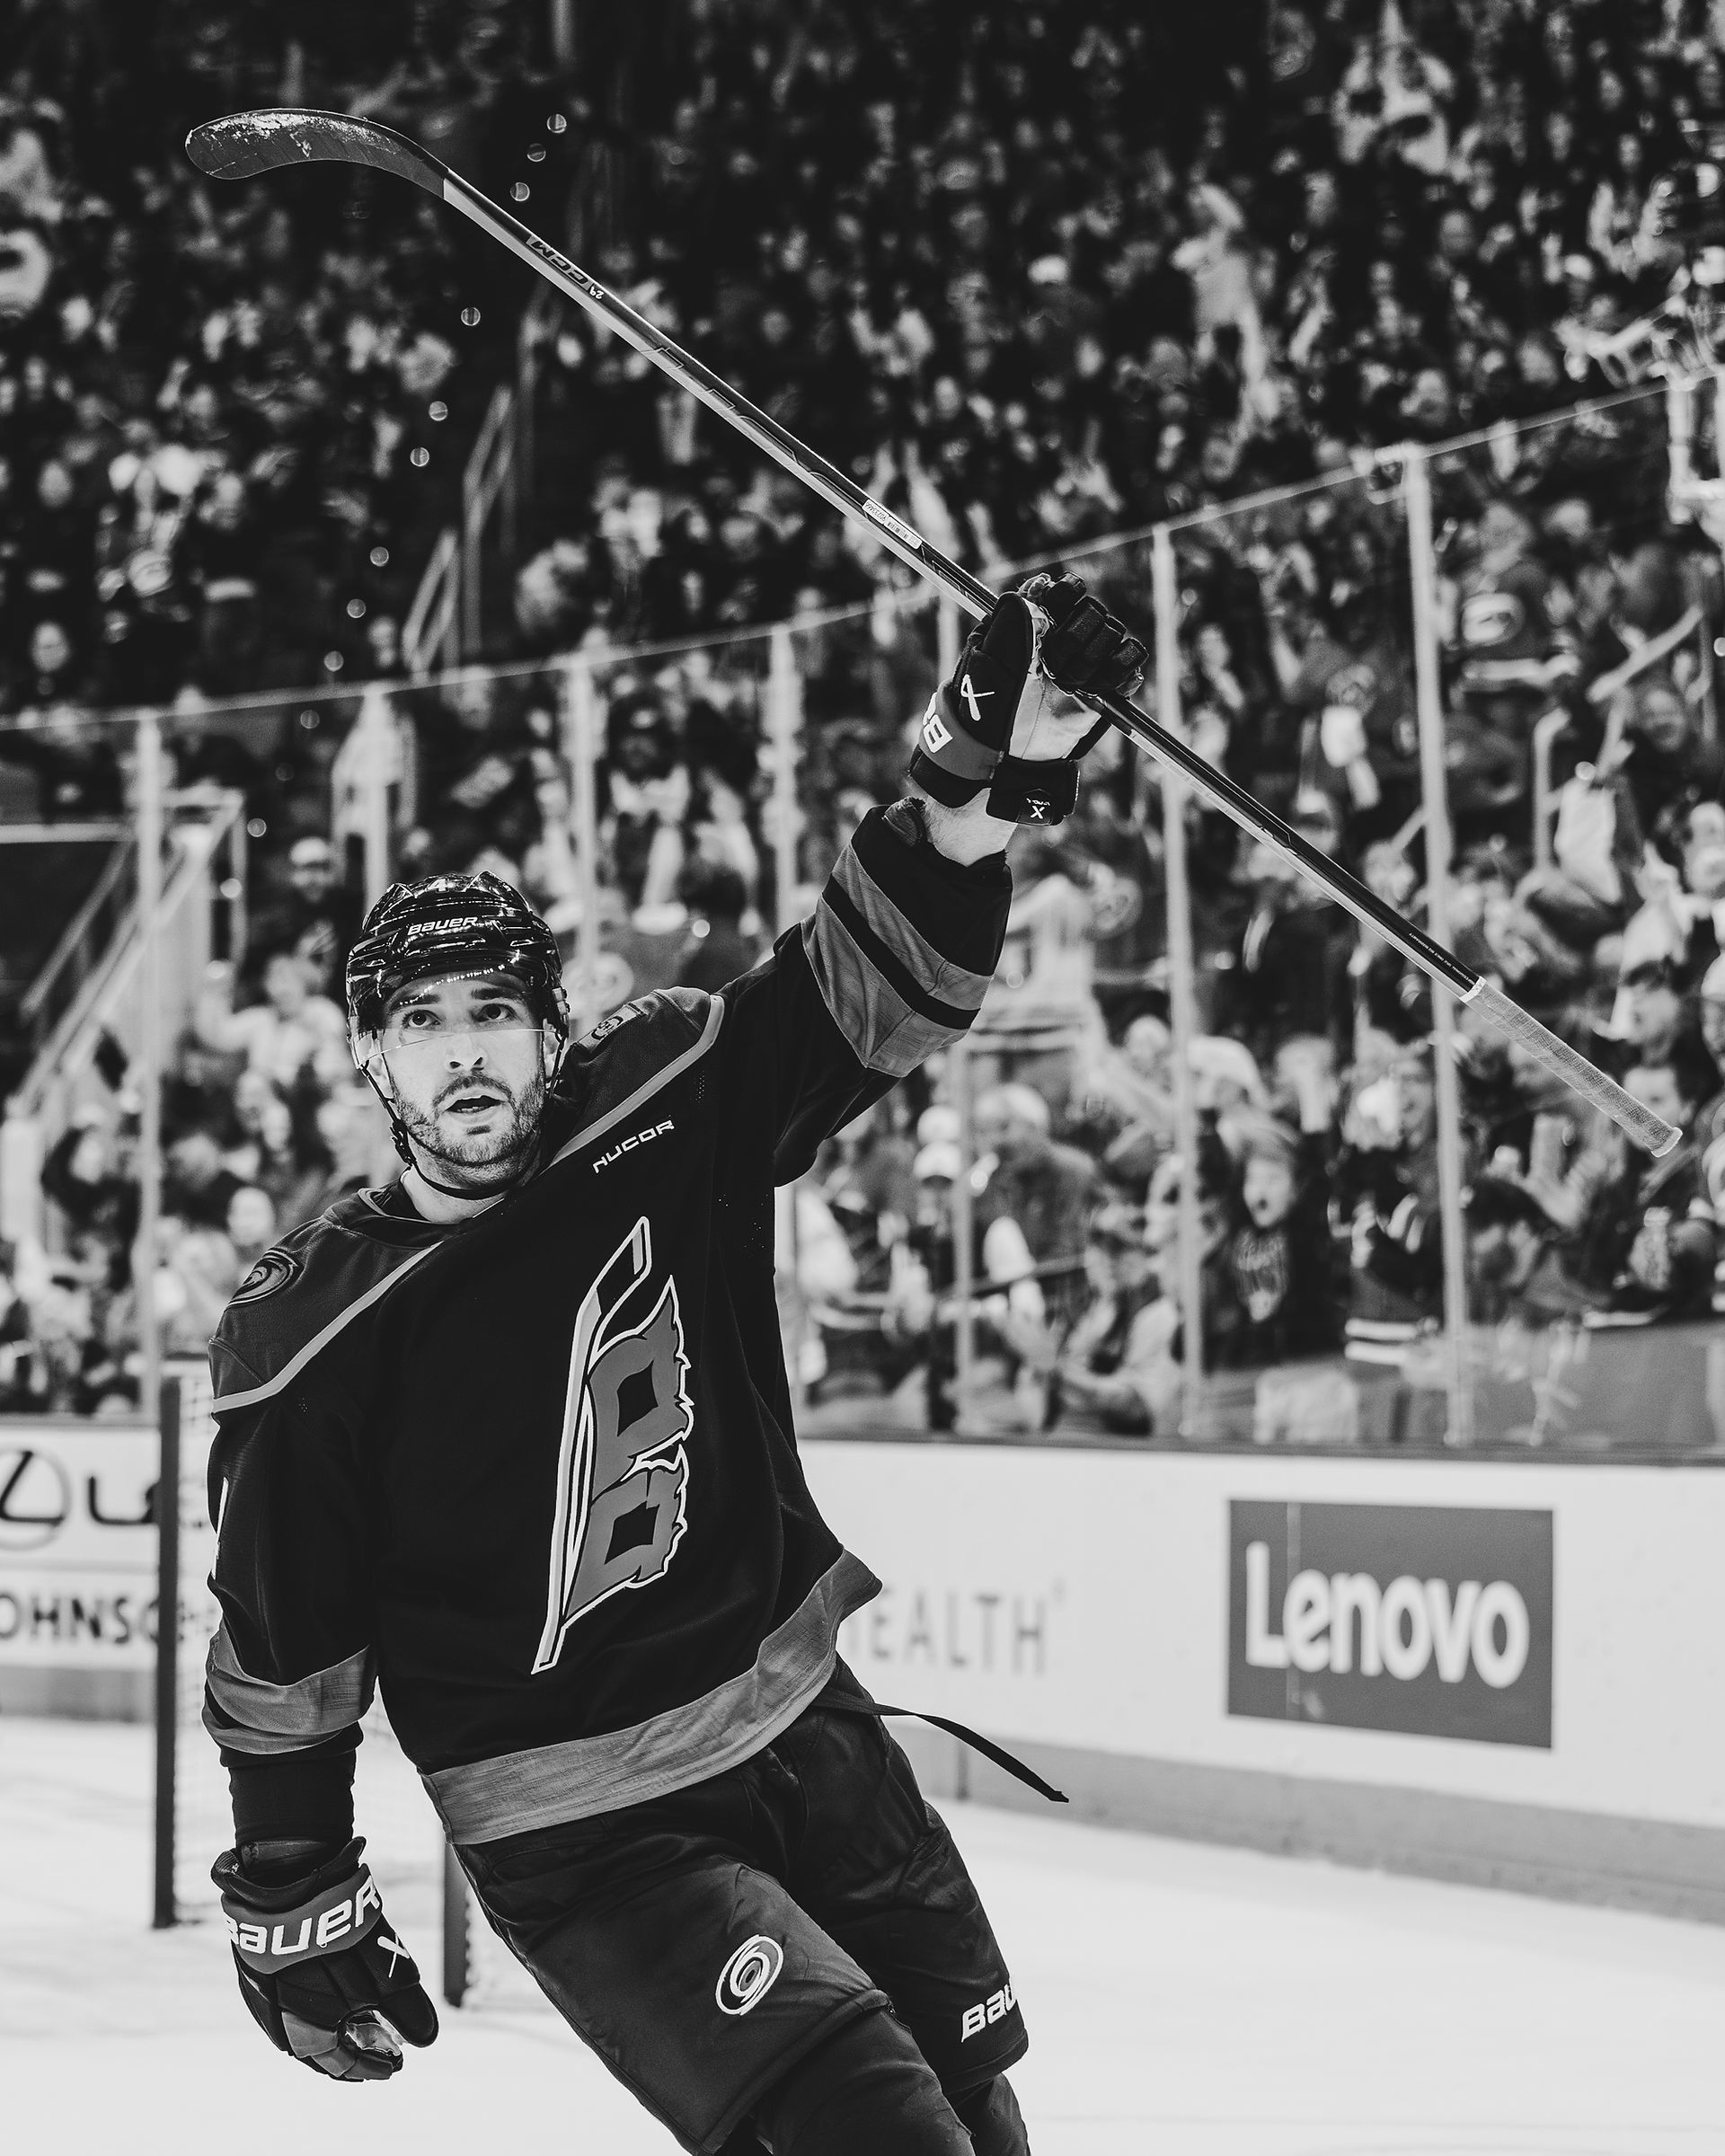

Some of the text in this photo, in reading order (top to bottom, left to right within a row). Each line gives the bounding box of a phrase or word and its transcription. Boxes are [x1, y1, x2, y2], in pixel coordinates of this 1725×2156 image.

[530, 241, 589, 285] CCM
[589, 286, 605, 299] 29
[593, 1119, 675, 1173] NUCOR
[1245, 1540, 1530, 1689] Lenovo
